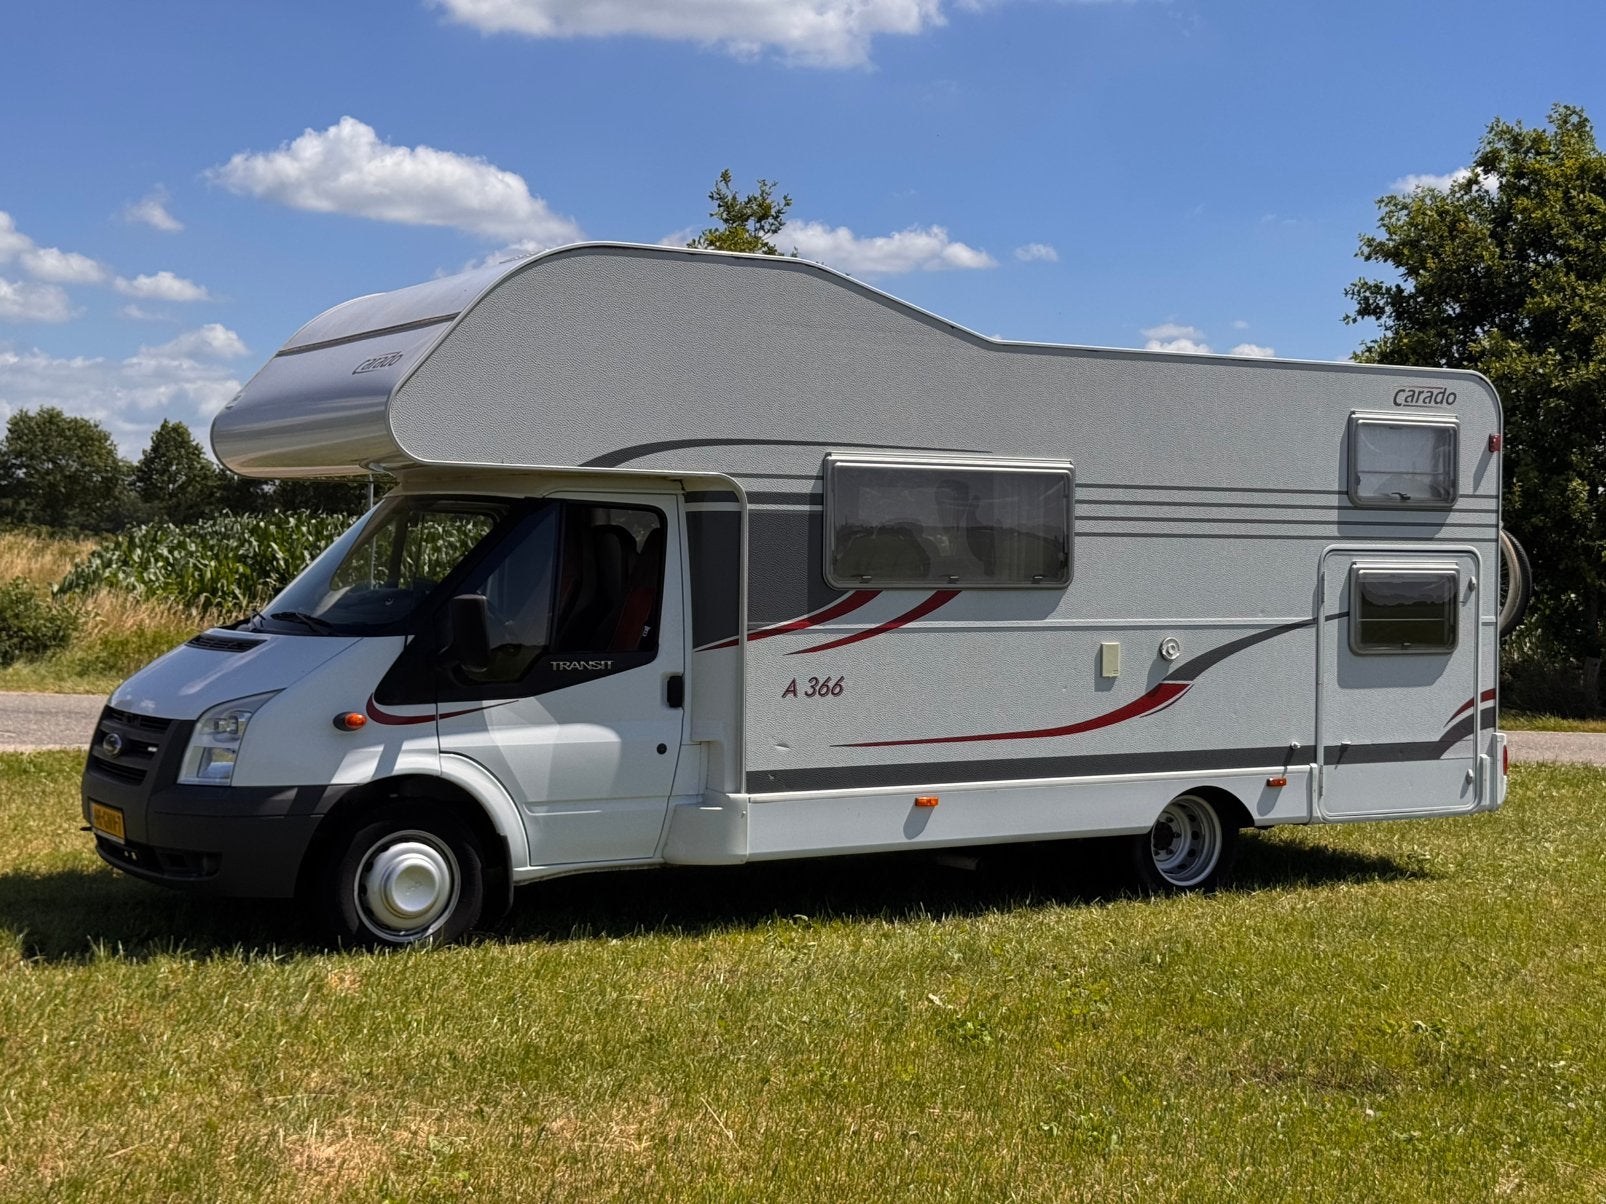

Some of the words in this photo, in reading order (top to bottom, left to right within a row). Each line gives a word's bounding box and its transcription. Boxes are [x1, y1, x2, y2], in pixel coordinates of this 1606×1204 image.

[1393, 387, 1457, 407] Carado
[550, 660, 614, 671] TRANSIT
[781, 677, 798, 698] A
[804, 675, 845, 698] 366
